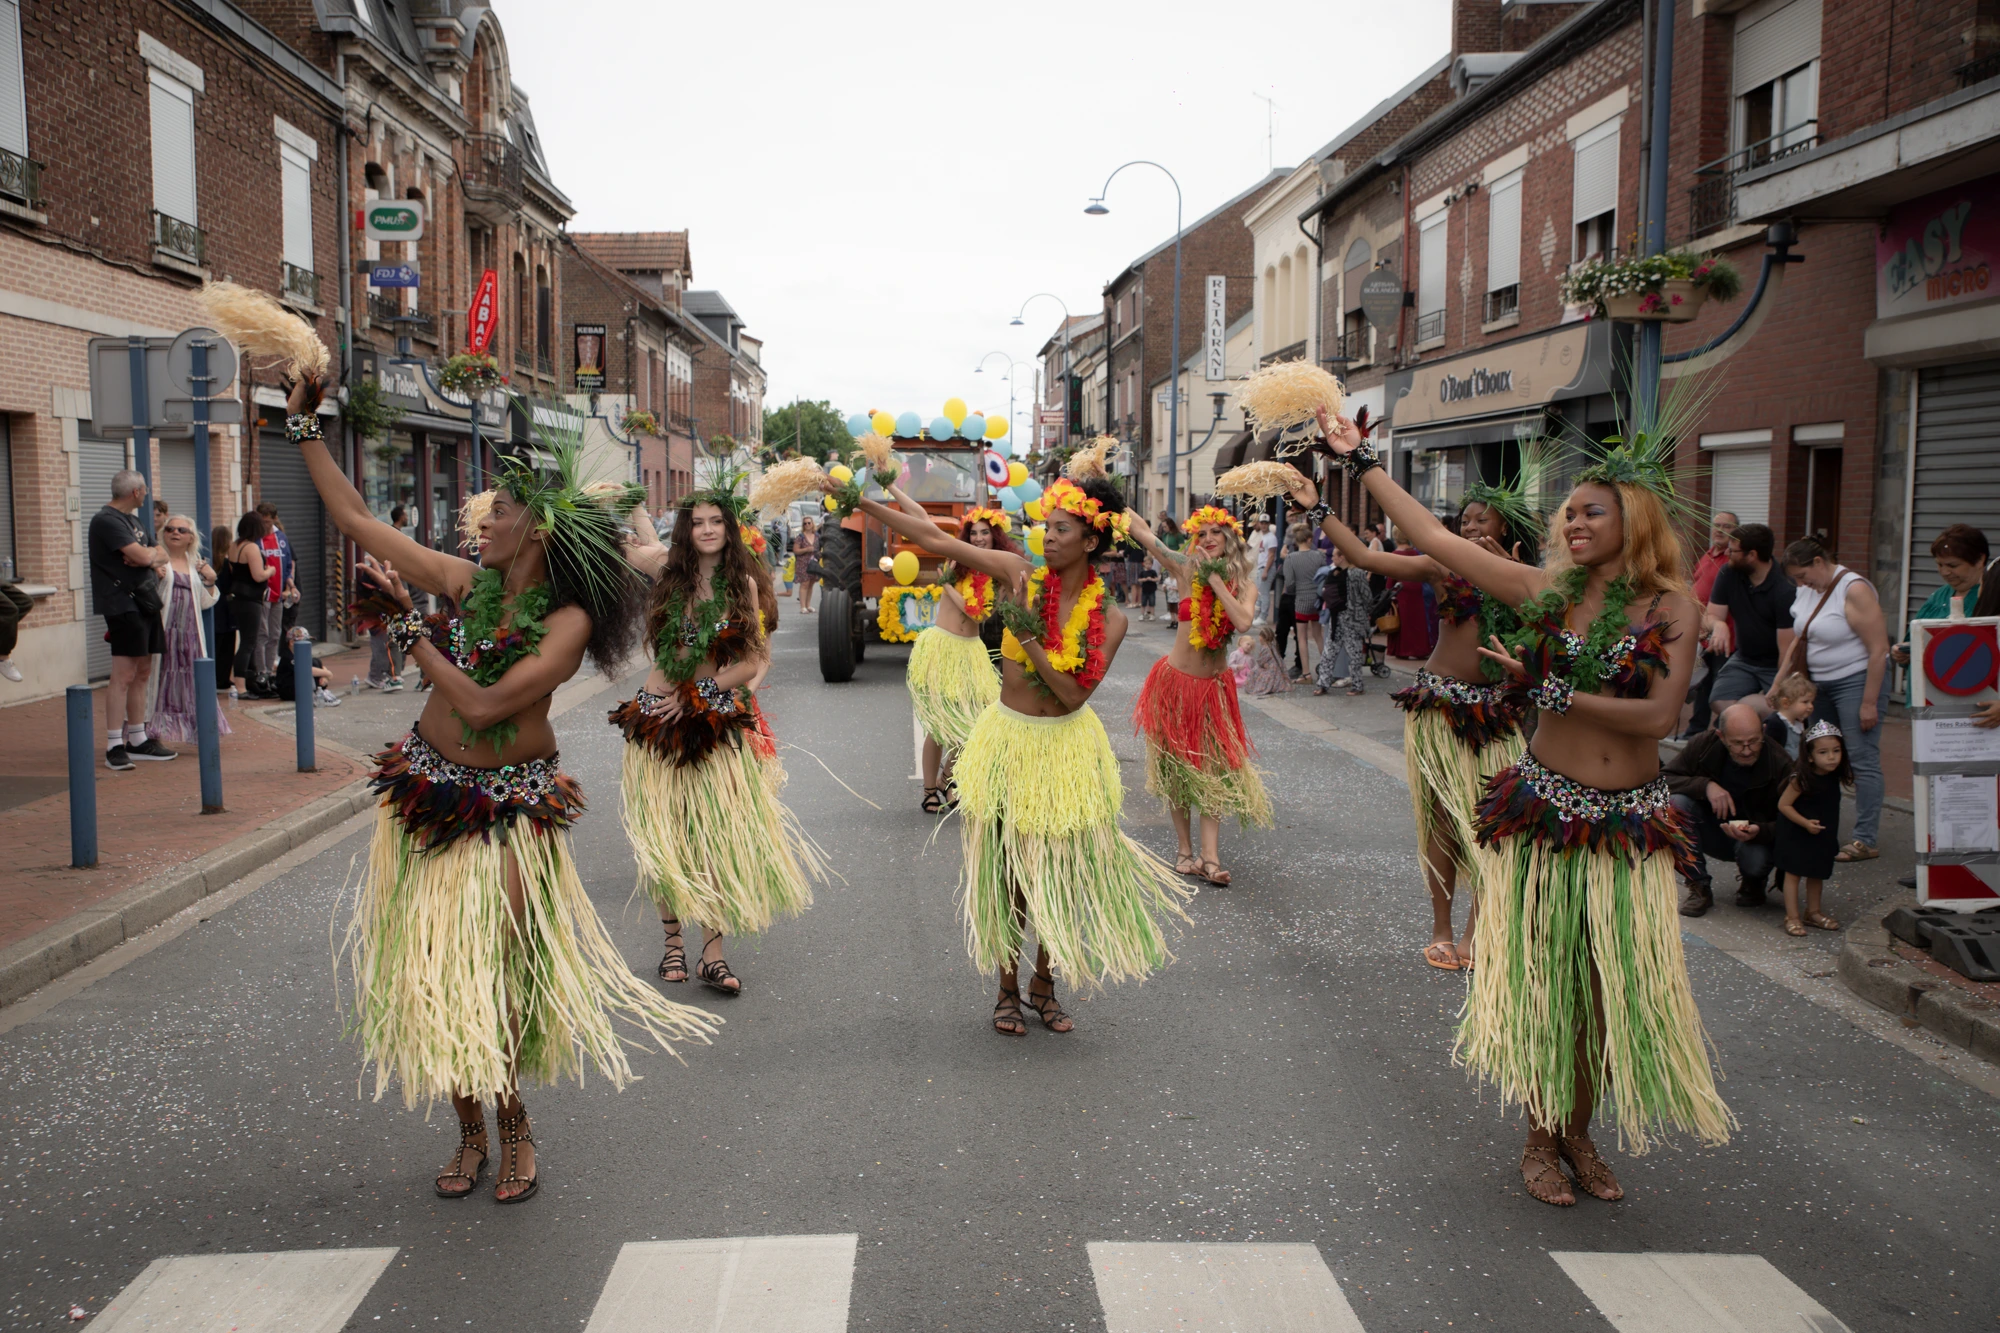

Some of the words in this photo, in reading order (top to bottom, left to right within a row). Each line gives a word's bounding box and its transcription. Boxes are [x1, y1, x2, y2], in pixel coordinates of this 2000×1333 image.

[374, 215, 396, 225] PMU
[1882, 201, 1972, 303] EASY
[376, 269, 395, 278] FDJ
[475, 282, 492, 346] TABAC
[576, 326, 605, 334] KEBAB
[1211, 279, 1222, 376] RESTAURANT
[380, 369, 394, 393] Bar
[395, 372, 419, 398] Tabac
[1072, 379, 1080, 433] PIZZA
